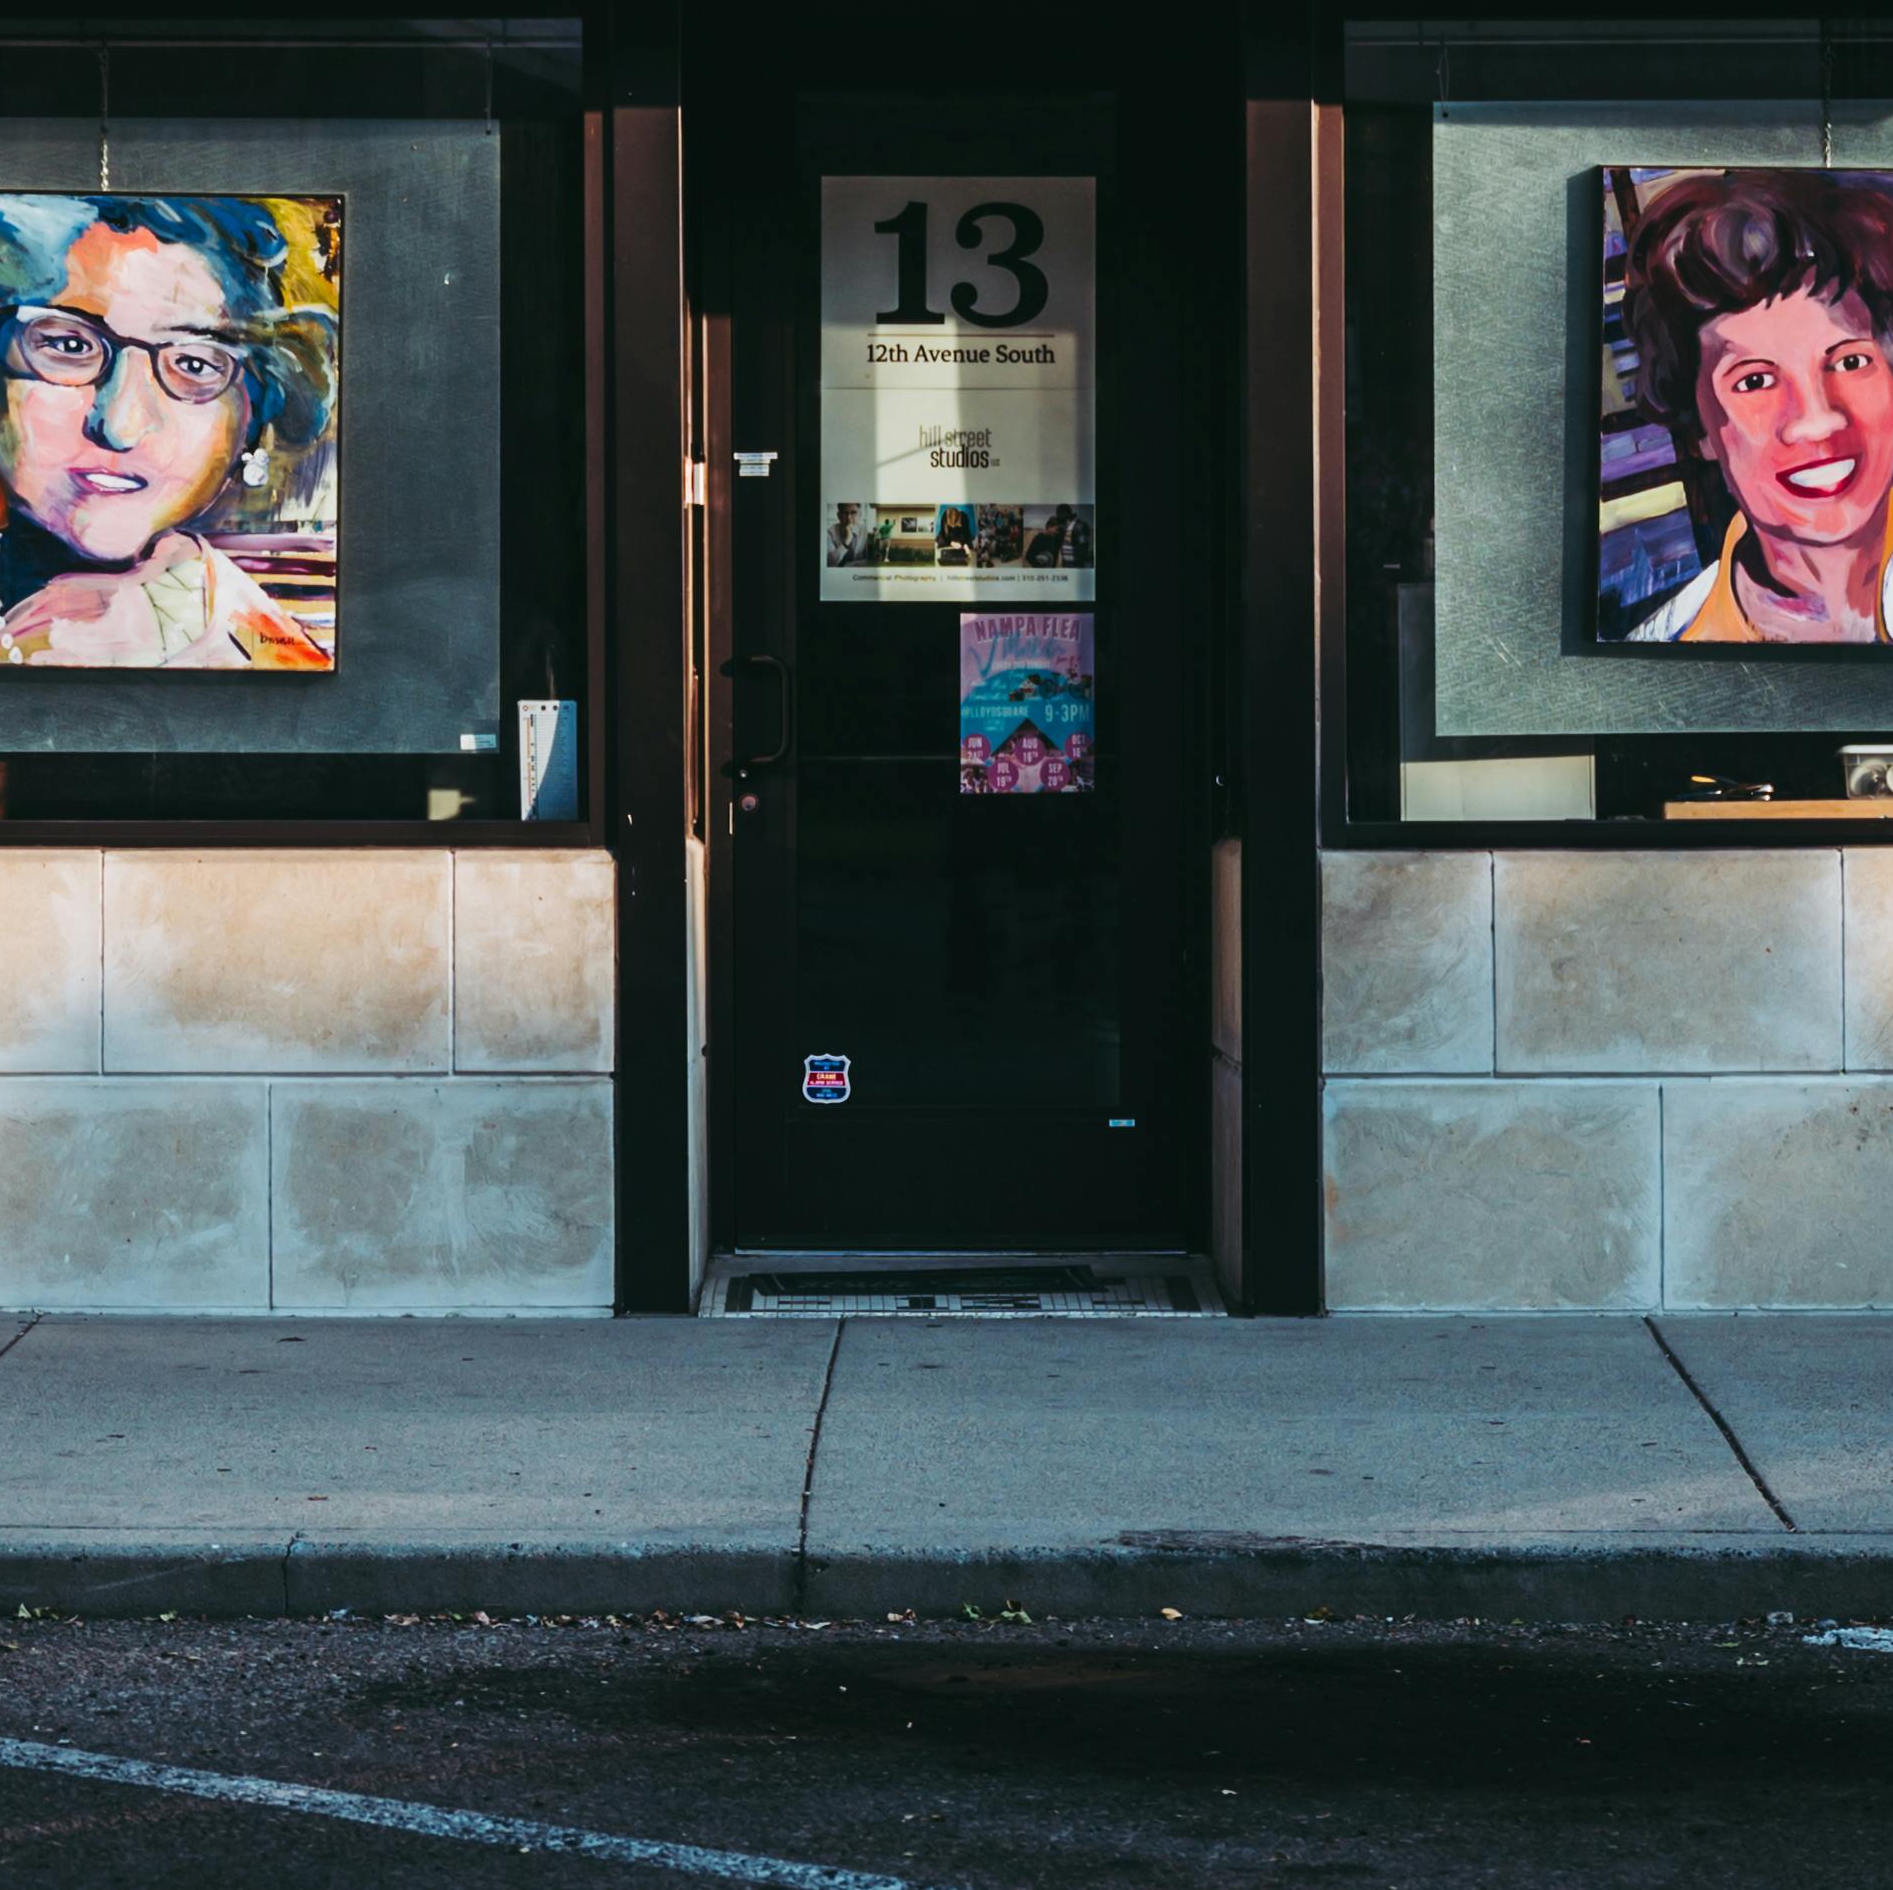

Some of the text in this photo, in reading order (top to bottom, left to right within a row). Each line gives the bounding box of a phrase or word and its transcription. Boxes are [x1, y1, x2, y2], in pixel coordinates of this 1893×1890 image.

[874, 200, 1049, 329] 13
[867, 344, 1056, 364] 12th Avenue South
[919, 424, 993, 448] hill street
[930, 444, 990, 469] studios
[974, 616, 1082, 643] NAMPA FLEA
